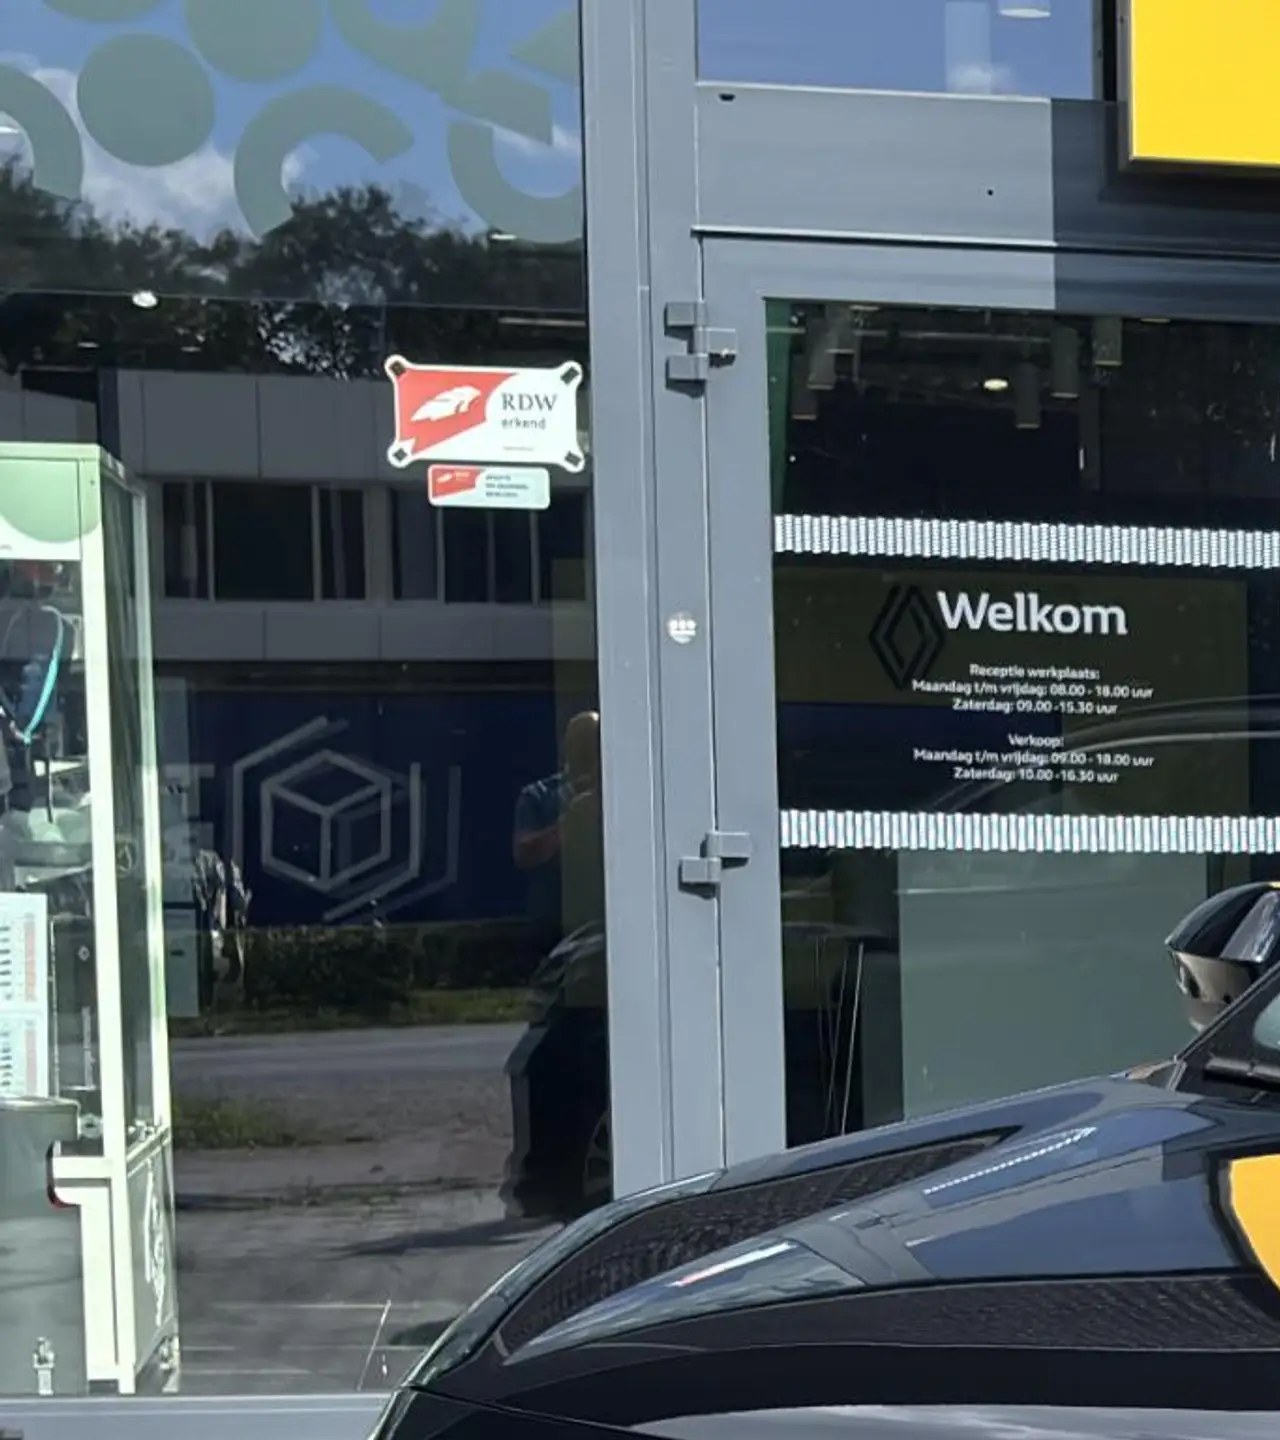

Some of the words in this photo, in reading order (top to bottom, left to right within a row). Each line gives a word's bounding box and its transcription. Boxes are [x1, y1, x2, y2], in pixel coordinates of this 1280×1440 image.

[501, 393, 558, 412] RDW
[501, 416, 547, 431] erkend
[936, 589, 1128, 636] Welkom
[969, 663, 1025, 678] Receptie
[1027, 665, 1100, 681] werkplaats:
[912, 679, 972, 696] Maandag
[974, 681, 998, 695] t/m
[999, 682, 1048, 698] vrijdag:
[1095, 684, 1130, 698] 18.00
[1131, 688, 1154, 699] uur
[952, 698, 1015, 714] Zaterdag:
[1016, 699, 1053, 714] 09.00
[1095, 704, 1119, 715] uur
[1007, 732, 1065, 749] Verkoop:
[913, 748, 973, 765] Maandag
[975, 750, 999, 764] t/m
[1000, 751, 1049, 767] vrijdag:
[1096, 753, 1131, 766] 18.00
[1132, 757, 1156, 767] uur
[953, 766, 1017, 783] Zaterdag:
[1018, 768, 1054, 781] 10.00
[1096, 772, 1119, 783] uur
